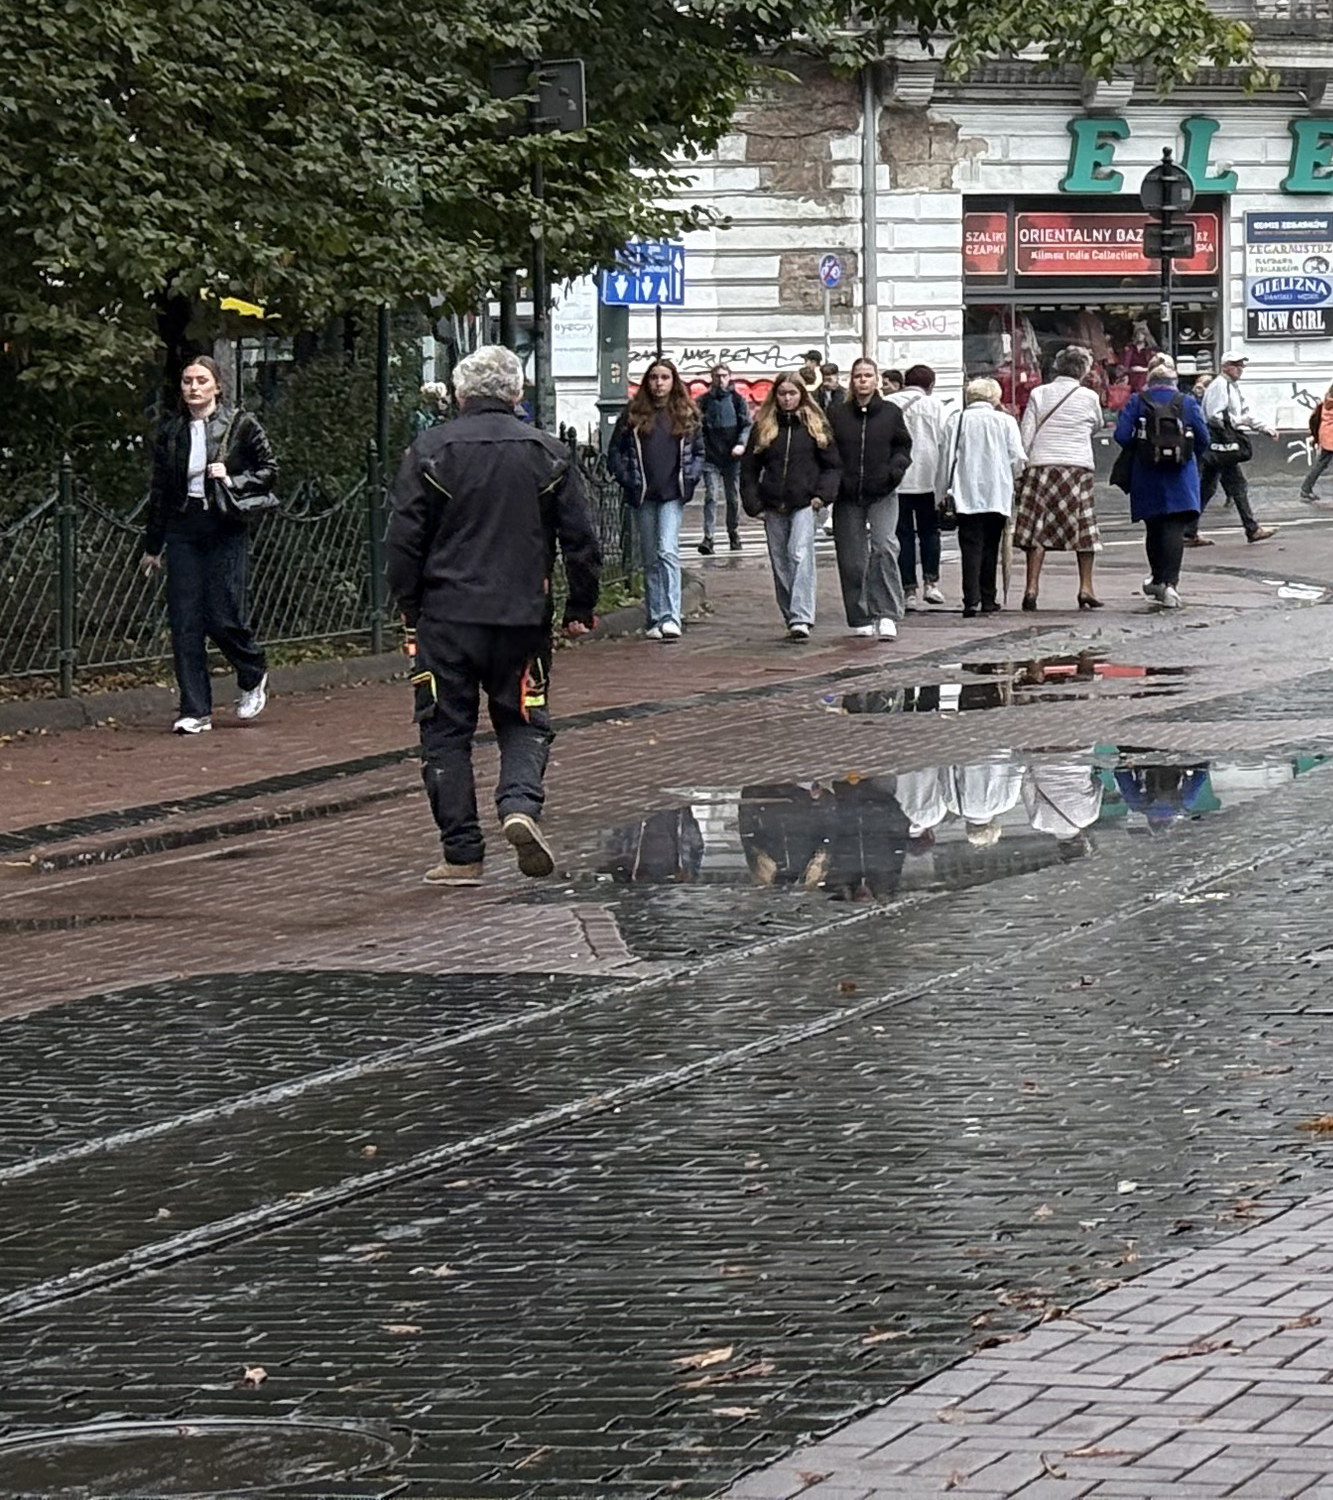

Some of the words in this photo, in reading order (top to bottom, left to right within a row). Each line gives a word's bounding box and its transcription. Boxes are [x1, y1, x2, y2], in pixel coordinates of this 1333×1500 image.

[965, 231, 1006, 242] SZALIKI
[1019, 228, 1112, 242] ORIENTALNY
[1116, 228, 1144, 242] BAZ
[965, 244, 1004, 255] CZAPKI
[1248, 244, 1333, 254] ZEGARMISTRZ
[1255, 277, 1328, 297] BIELIZNA
[1257, 310, 1290, 331] NEW
[1292, 310, 1326, 330] GIRL
